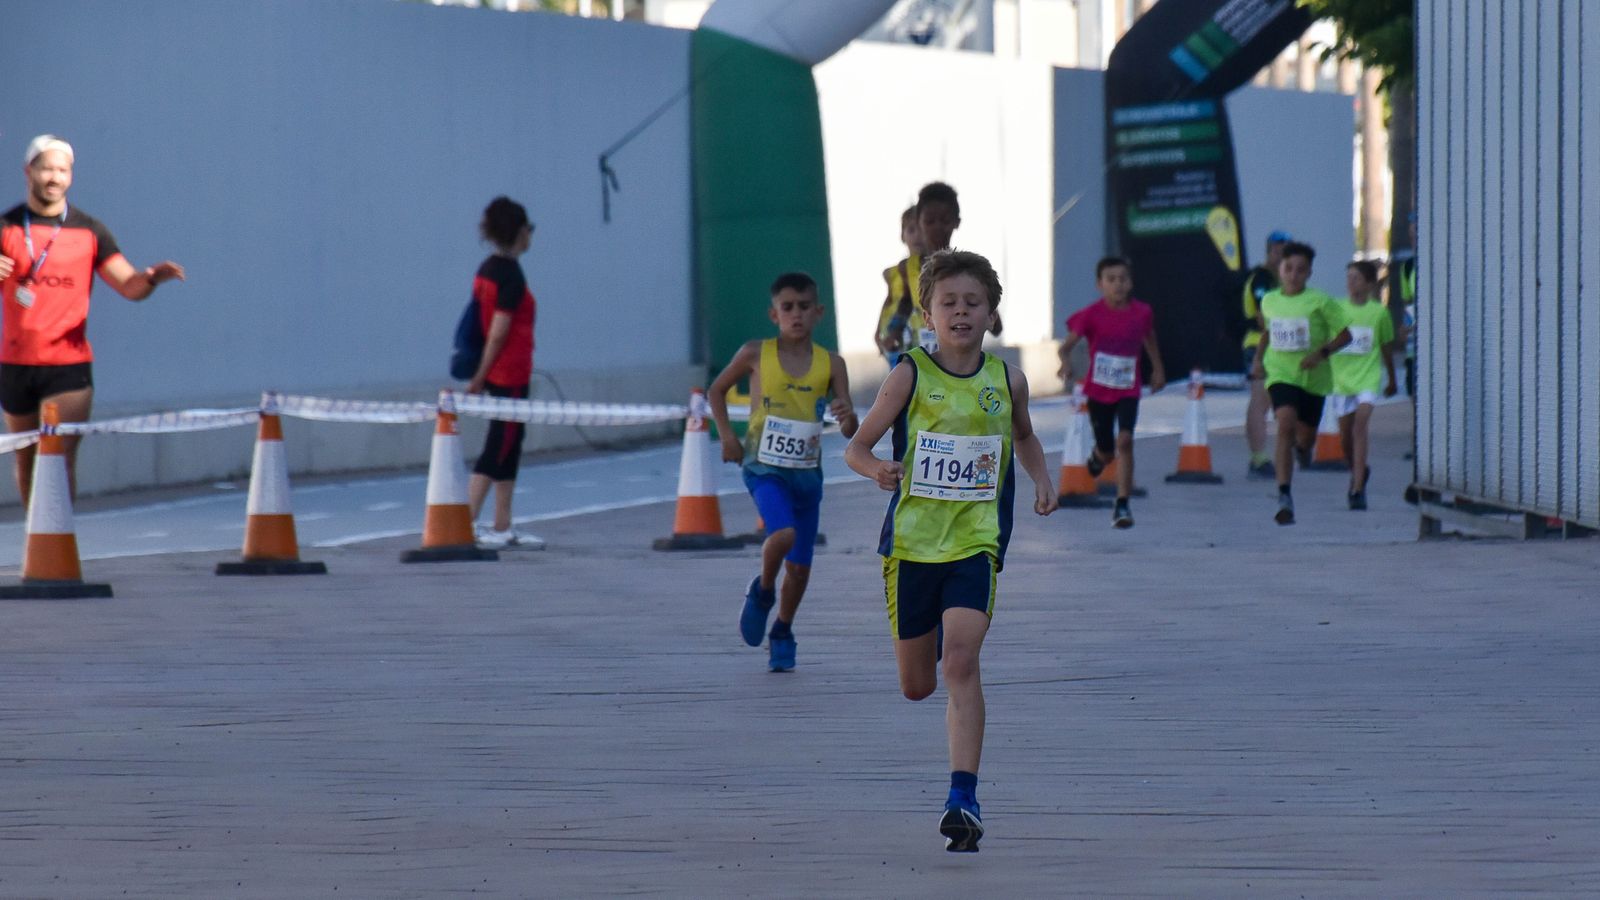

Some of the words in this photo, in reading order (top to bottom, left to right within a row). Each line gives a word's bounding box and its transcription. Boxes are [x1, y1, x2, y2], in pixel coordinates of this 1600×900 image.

[766, 434, 805, 456] 1553
[920, 438, 937, 449] XXI
[920, 456, 974, 483] 1194
